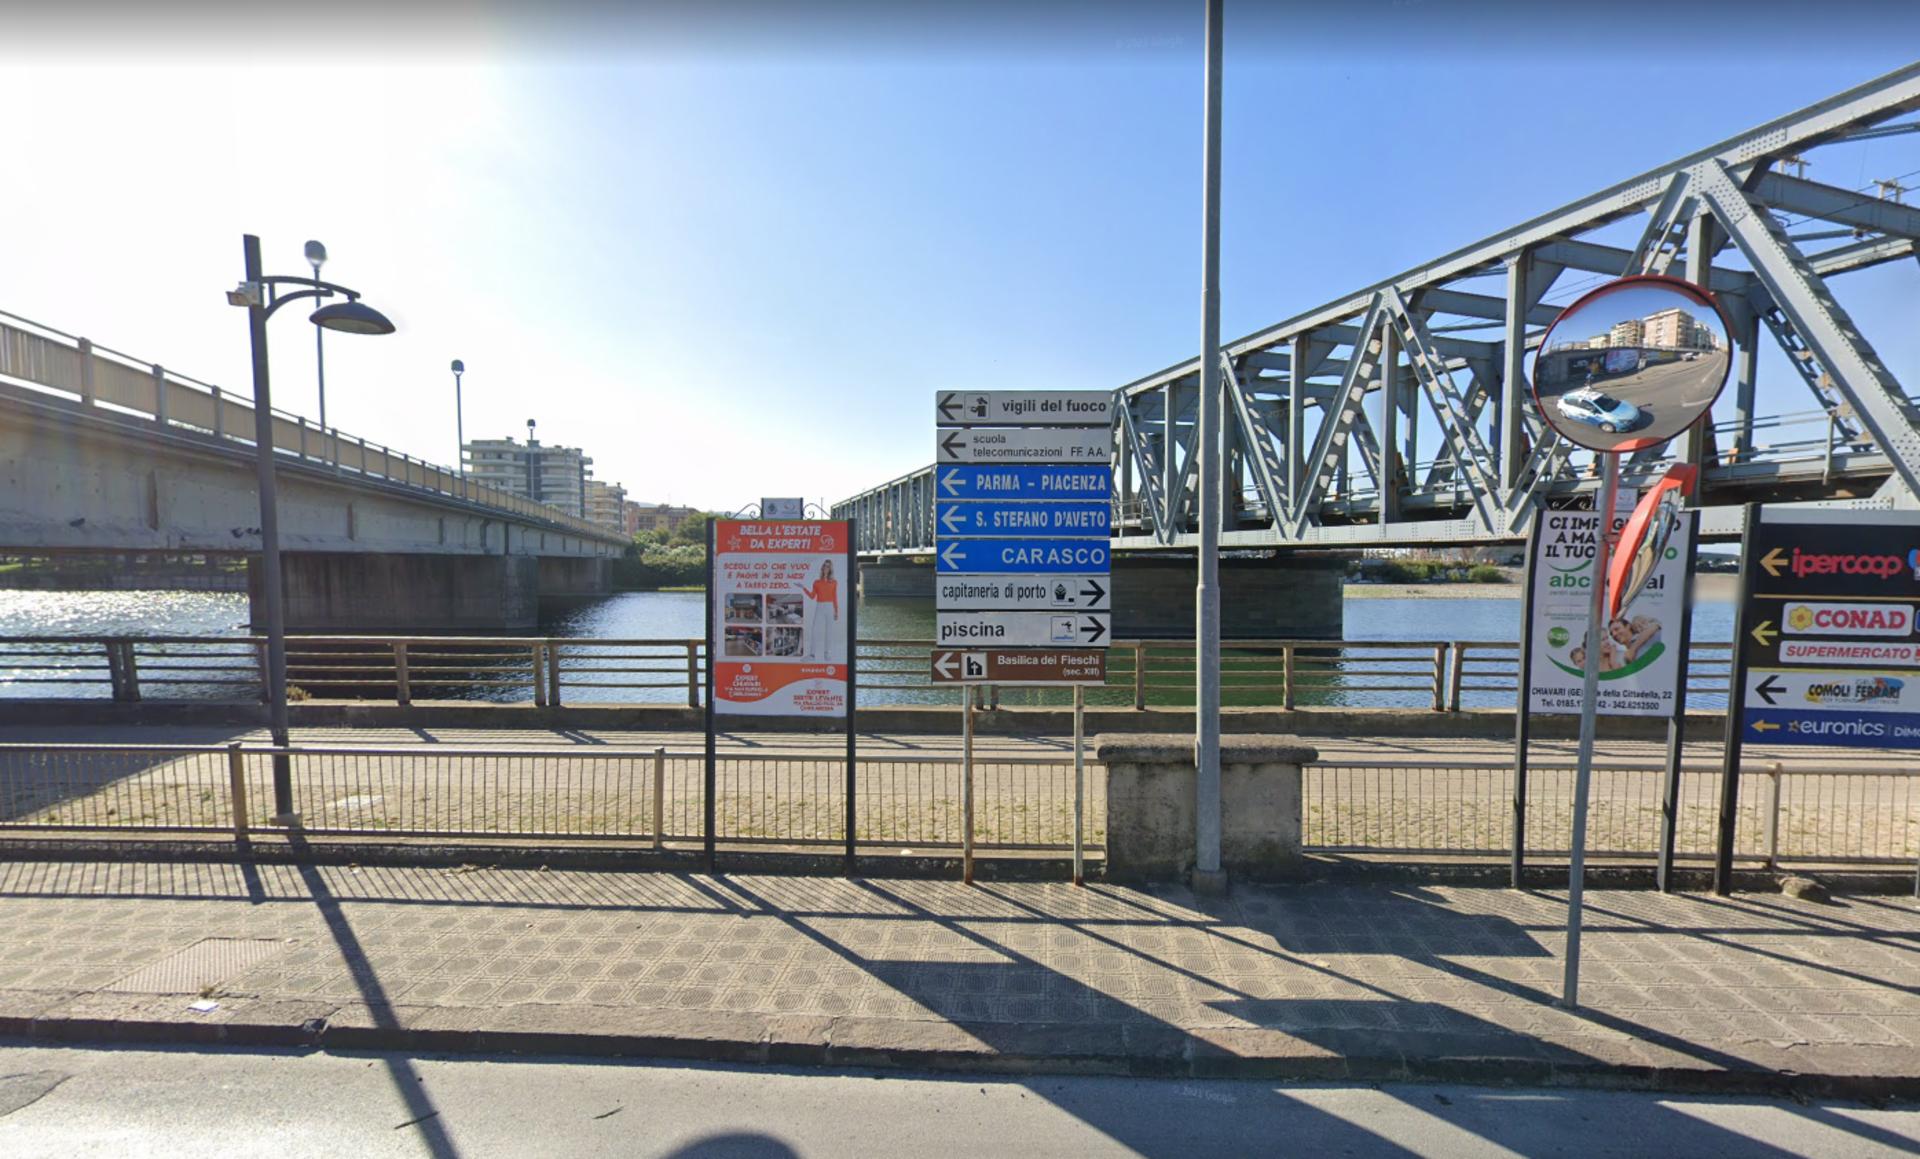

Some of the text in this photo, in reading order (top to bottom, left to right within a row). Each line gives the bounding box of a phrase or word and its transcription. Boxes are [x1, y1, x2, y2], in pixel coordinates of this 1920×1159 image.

[1002, 400, 1107, 414] vigili del fuoco
[973, 434, 1006, 444] scuola
[973, 447, 1063, 457] telecomunicazioni
[976, 474, 1020, 490] PARMA
[1041, 474, 1106, 490] PIACENZA
[976, 511, 1106, 527] S. STEFANO D'AVETO
[1549, 517, 1569, 530] CI
[740, 525, 821, 536] BELLA L'ESTATE
[1555, 531, 1567, 544] A
[750, 538, 765, 549] DA
[768, 538, 811, 549] EXPERTI
[1002, 548, 1105, 565] CARASCO
[1545, 545, 1559, 558] IL
[1792, 547, 1904, 580] ipercoop
[942, 582, 1046, 601] capitaneria di porto
[1814, 610, 1906, 629] CONAD
[941, 621, 1005, 640] piscina
[1786, 645, 1911, 660] SUPERMERCATO
[997, 655, 1100, 665] Basilica dei Fieschi
[1531, 688, 1566, 696] CHIAVARI
[1602, 690, 1621, 698] della
[1662, 691, 1673, 699] 22
[1808, 683, 1901, 700] COMOLI FERRARI
[1541, 699, 1555, 707] Tel.
[1800, 719, 1885, 736] euronics
